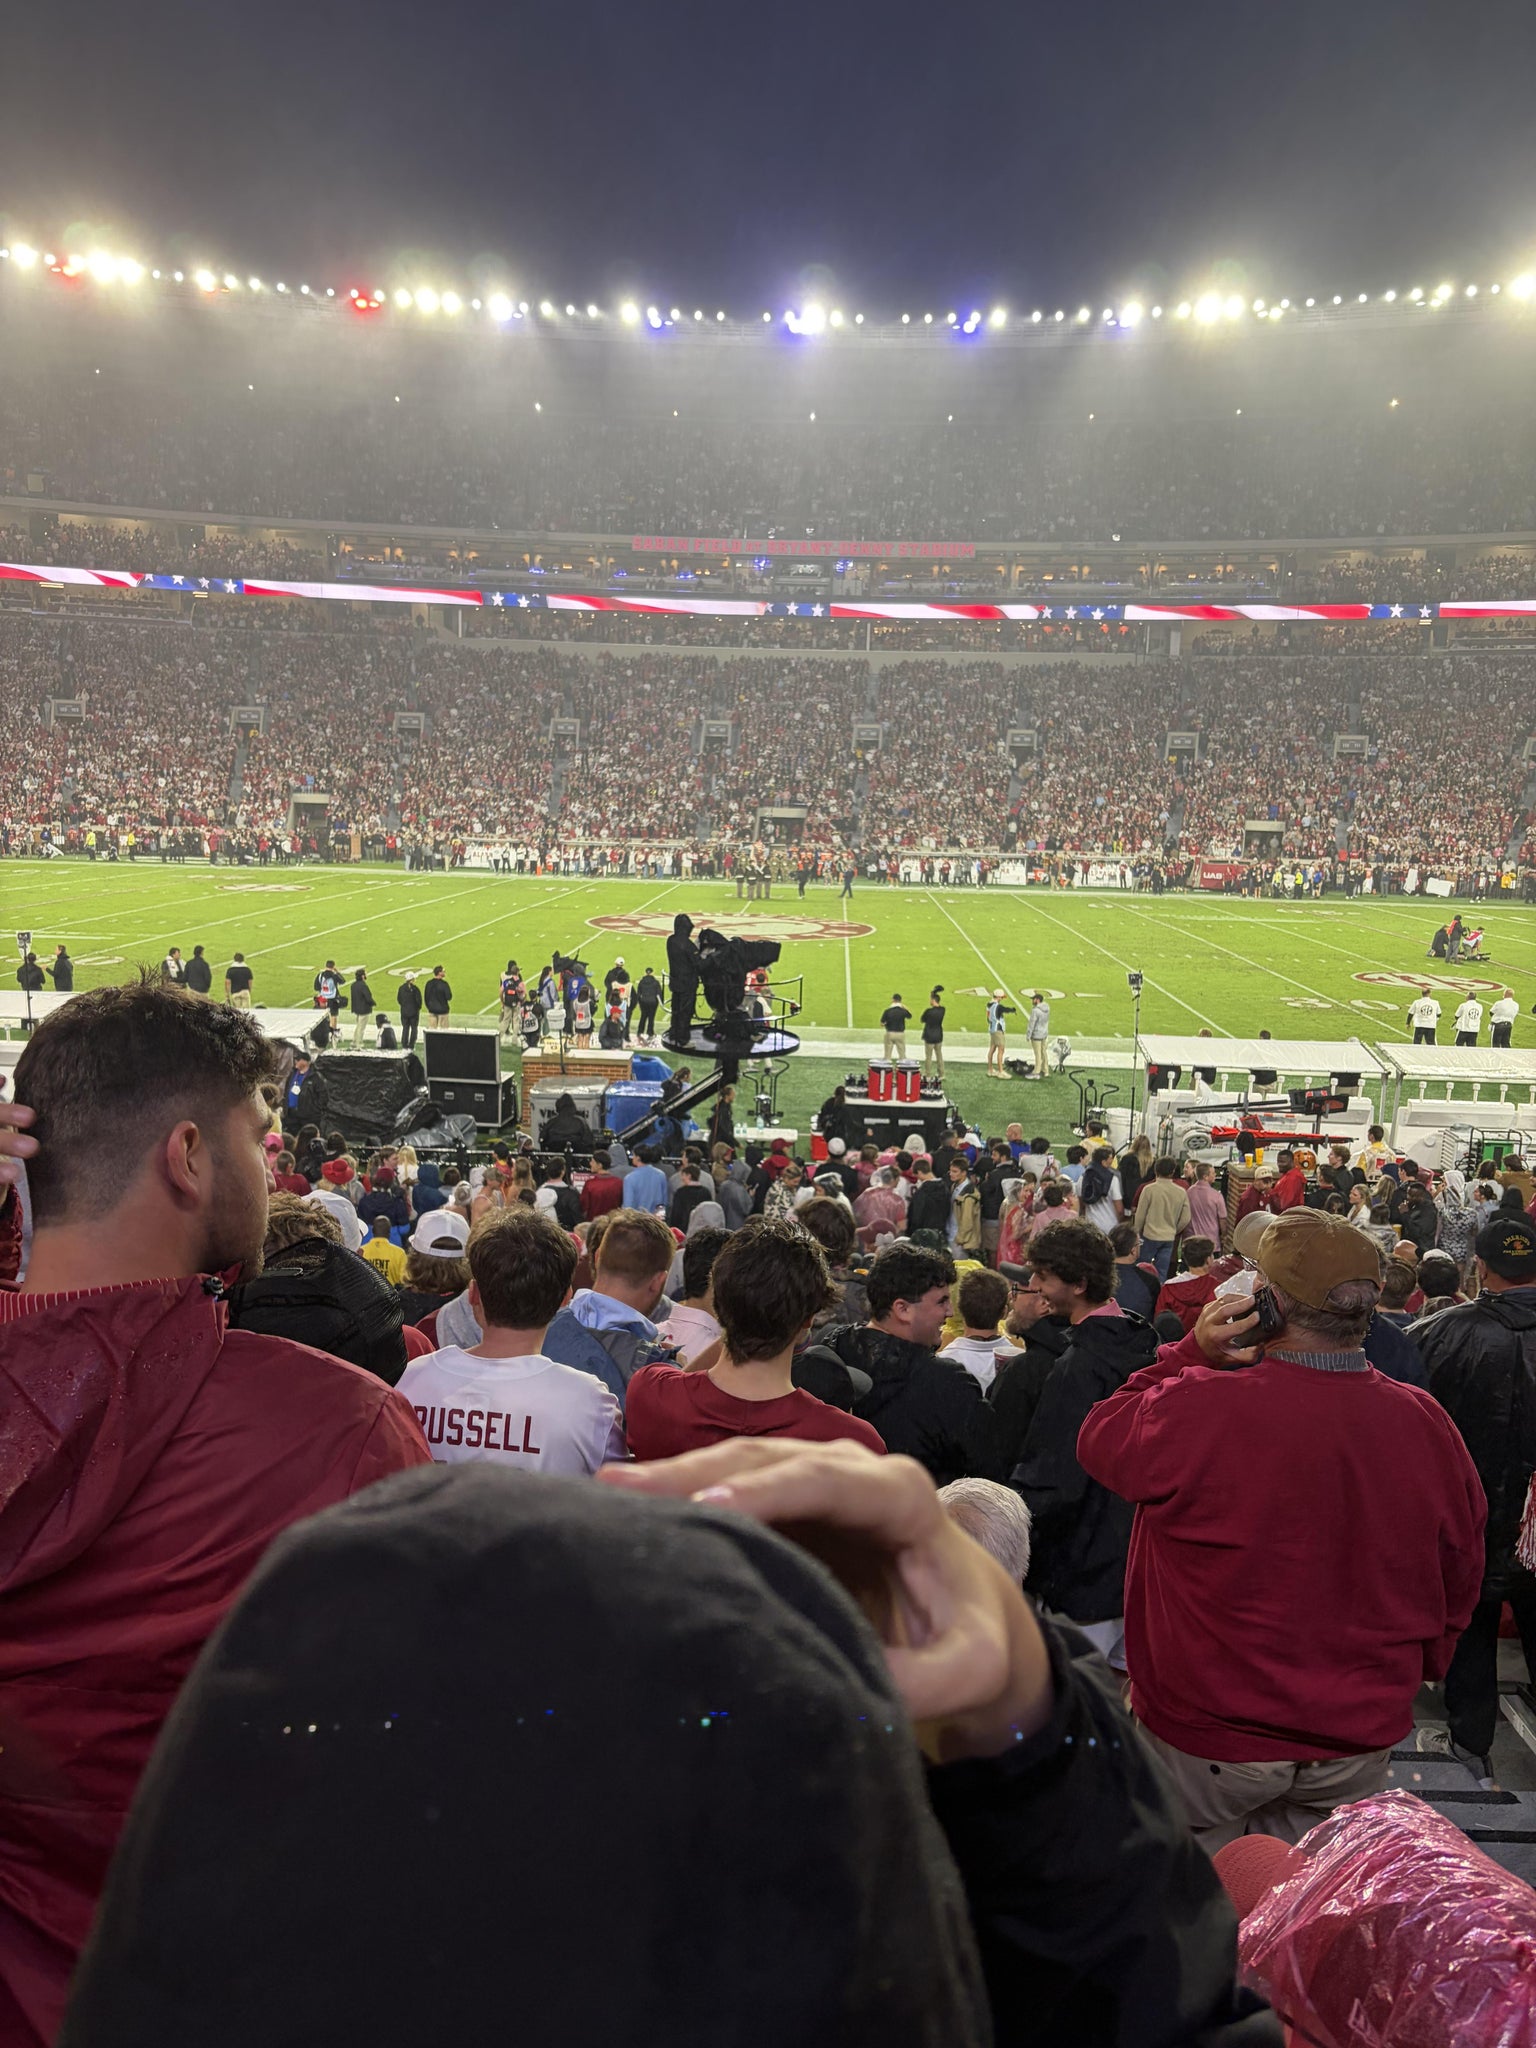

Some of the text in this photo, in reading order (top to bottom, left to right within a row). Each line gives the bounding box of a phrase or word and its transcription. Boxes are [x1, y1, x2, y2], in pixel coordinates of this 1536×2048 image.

[694, 538, 742, 553] FIELD
[767, 540, 894, 556] BRYANT-DENNY
[898, 542, 975, 557] STADIUM
[1203, 872, 1223, 880] UAB
